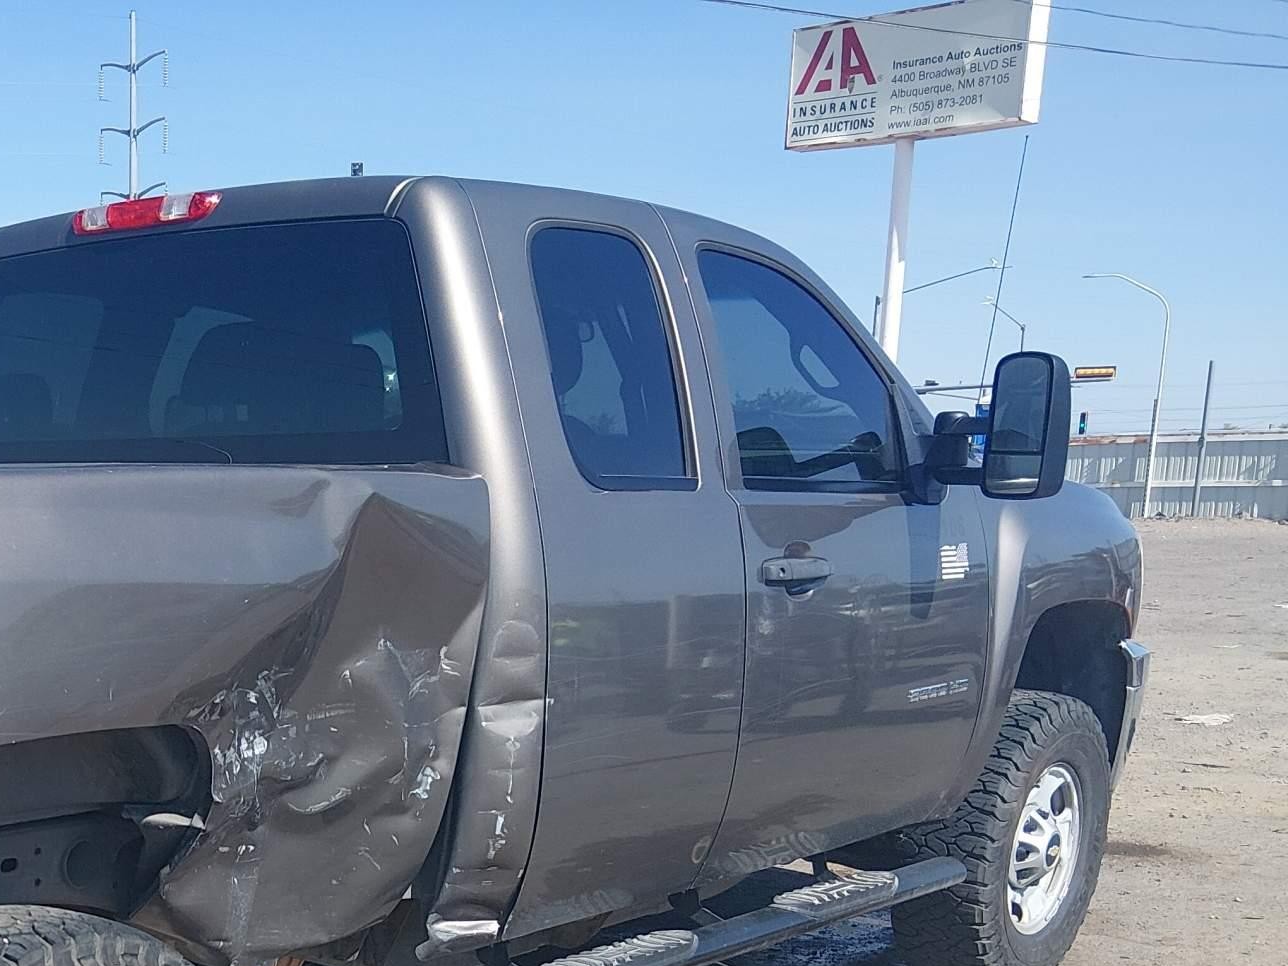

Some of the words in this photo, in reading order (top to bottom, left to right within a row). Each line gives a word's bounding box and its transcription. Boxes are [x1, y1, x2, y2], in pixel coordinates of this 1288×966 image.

[892, 55, 944, 70] Insurance
[946, 49, 971, 61] Auto
[974, 42, 1023, 57] Auctions
[891, 71, 916, 84] 4400
[918, 64, 966, 81] Broadway
[969, 59, 999, 73] BLVD
[1001, 56, 1017, 68] SE
[890, 82, 954, 99] Albuquerque,
[957, 77, 975, 90] NM
[977, 72, 1010, 87] 87105
[793, 97, 877, 118] INSURANCE
[908, 100, 934, 115] (505)
[936, 94, 983, 110] 873-2081
[791, 123, 819, 138] AUTO
[821, 117, 875, 134] AUCTIONS
[887, 114, 954, 129] www.iaai.com
